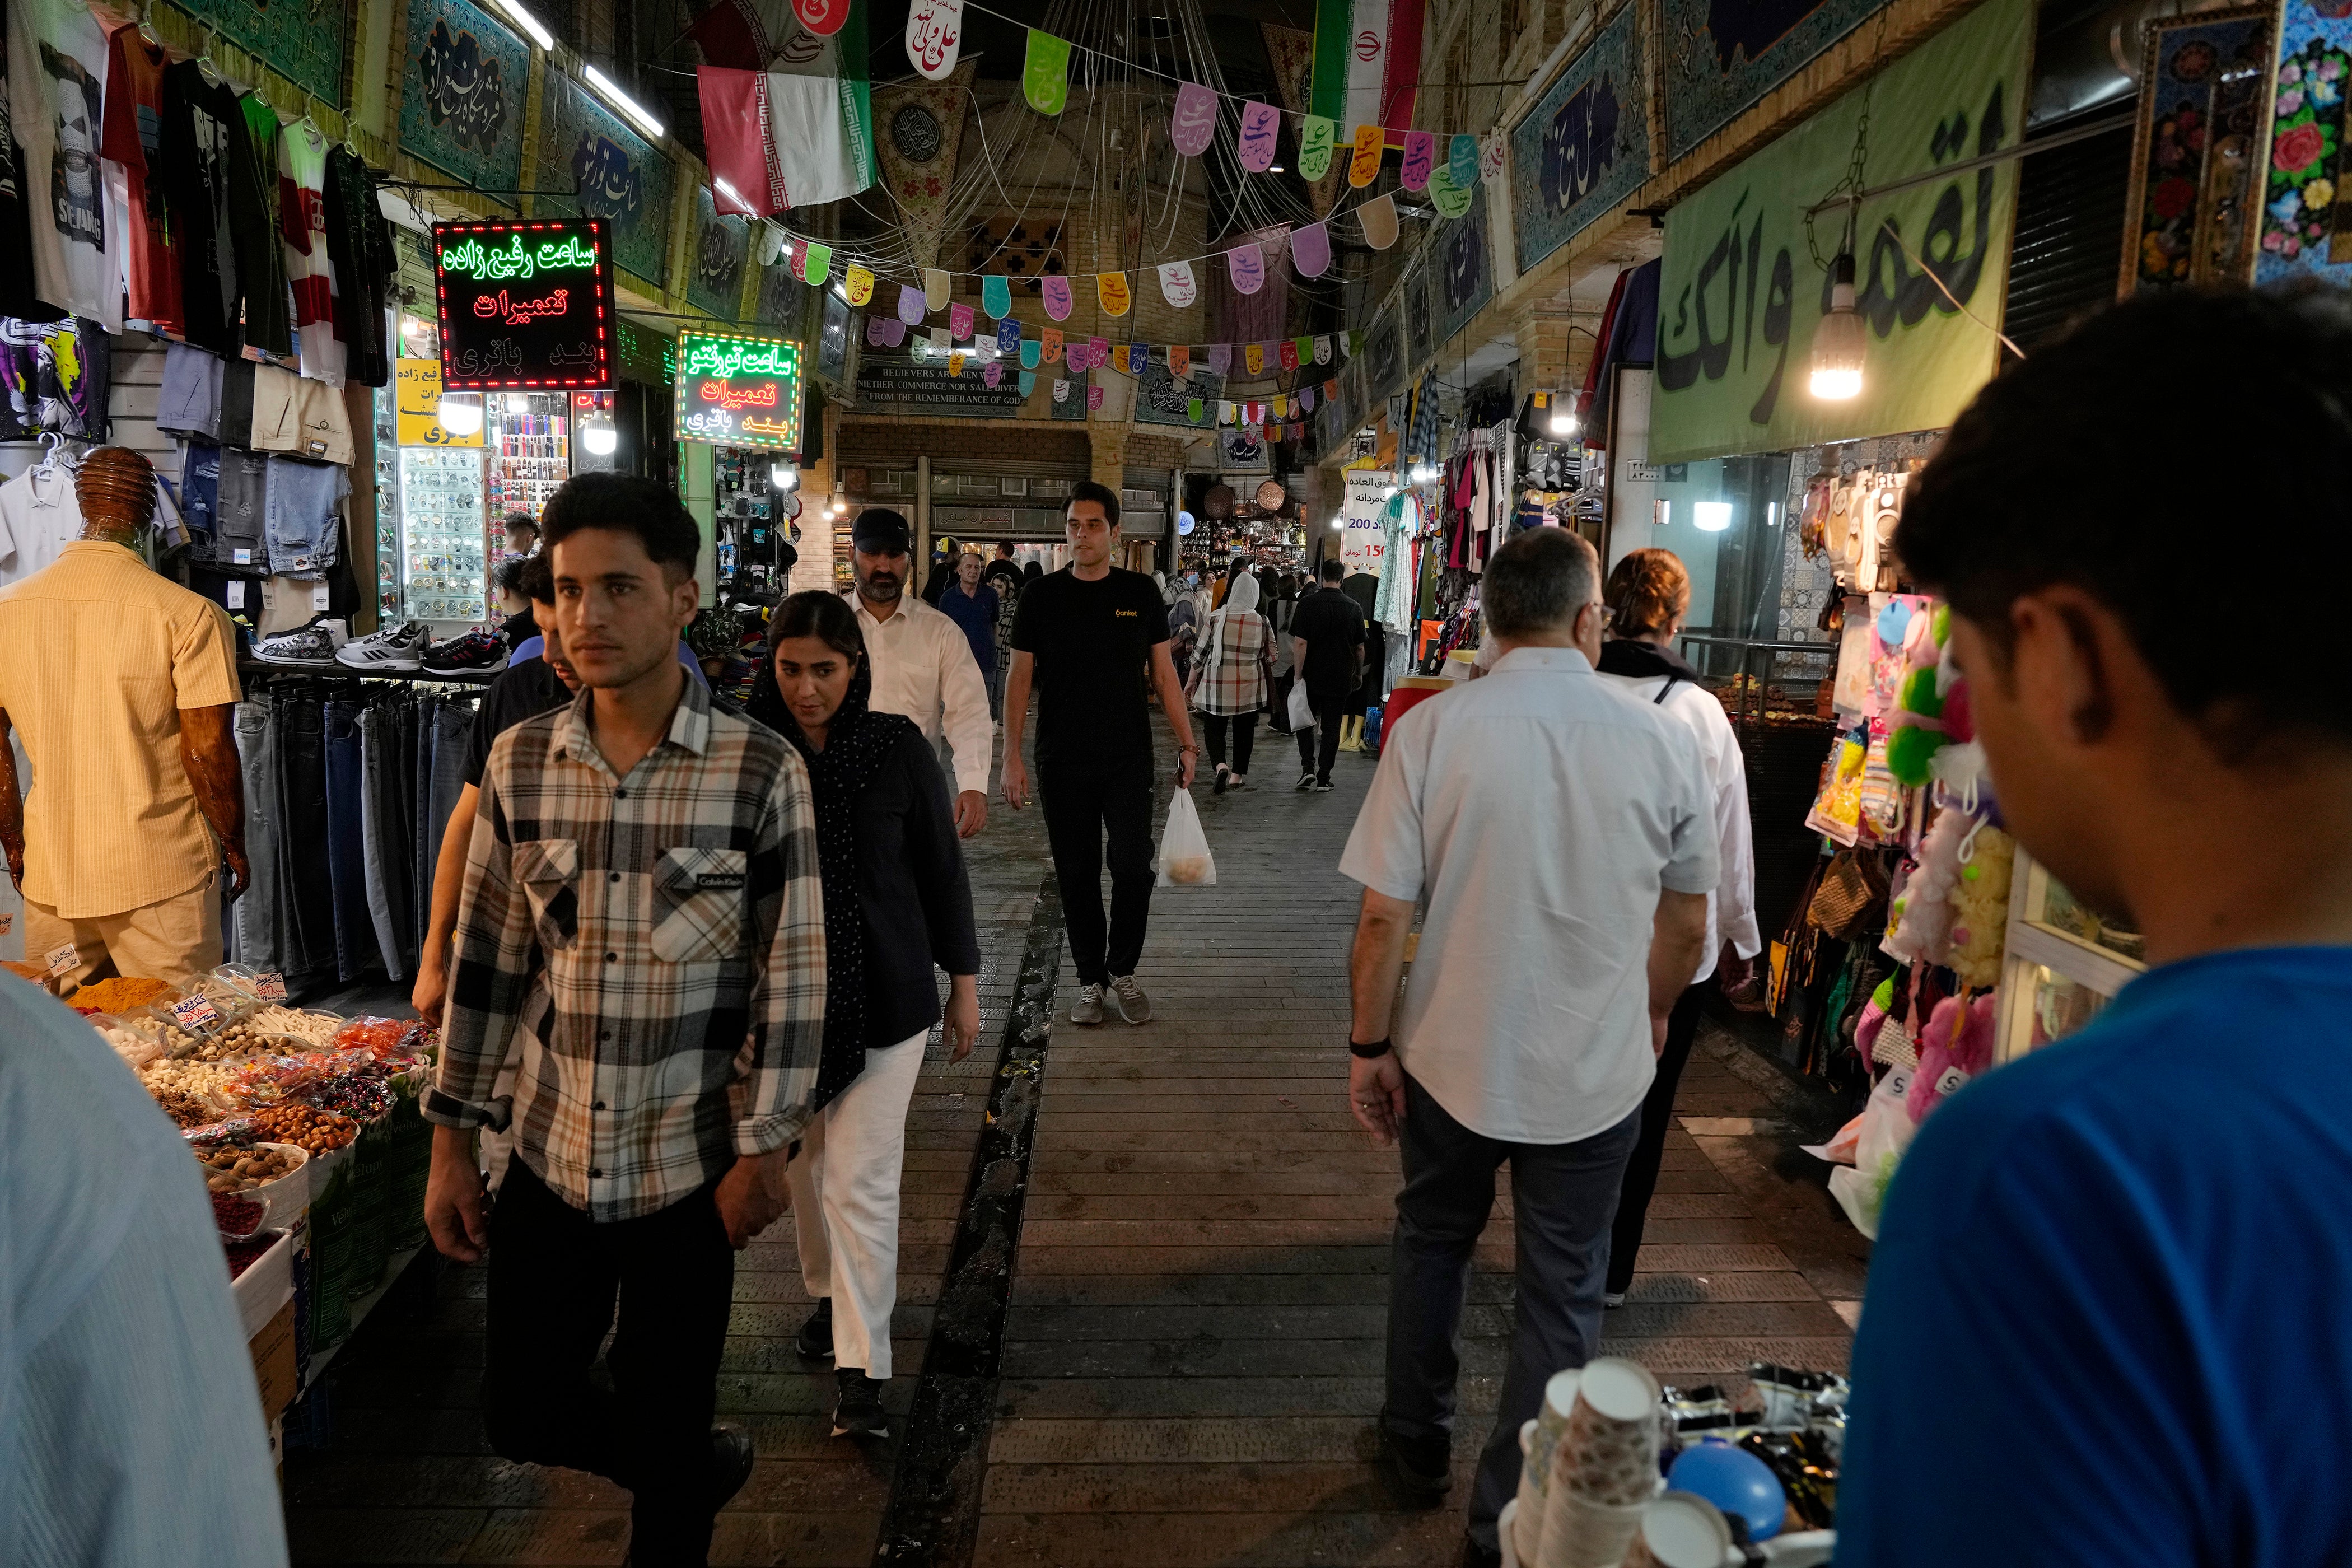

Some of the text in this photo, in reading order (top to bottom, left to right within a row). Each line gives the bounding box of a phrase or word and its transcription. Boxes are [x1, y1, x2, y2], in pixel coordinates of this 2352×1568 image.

[442, 234, 595, 279] ساعت رفیع زاده
[474, 289, 569, 325] تعمیرات
[453, 338, 522, 376] باتری
[549, 342, 597, 372] بند
[688, 343, 744, 378] تورنتو
[742, 348, 791, 375] ساعت
[398, 368, 419, 381] زاده
[883, 368, 935, 377] BELIEVERS
[959, 371, 977, 379] MEN
[857, 380, 894, 389] NIETHER
[897, 381, 946, 390] COMMERCE
[949, 382, 967, 391] NOR
[970, 384, 992, 392] SALE
[702, 379, 776, 409] تعمیرات
[870, 393, 894, 401] FROM
[915, 394, 988, 403] REMEMBERANCE
[400, 404, 438, 419] شیشه
[687, 408, 788, 440] بند باتری
[1349, 477, 1373, 486] العاده
[1356, 493, 1379, 505] مردانه
[970, 511, 1012, 526] شمیران
[1348, 518, 1371, 529] 200
